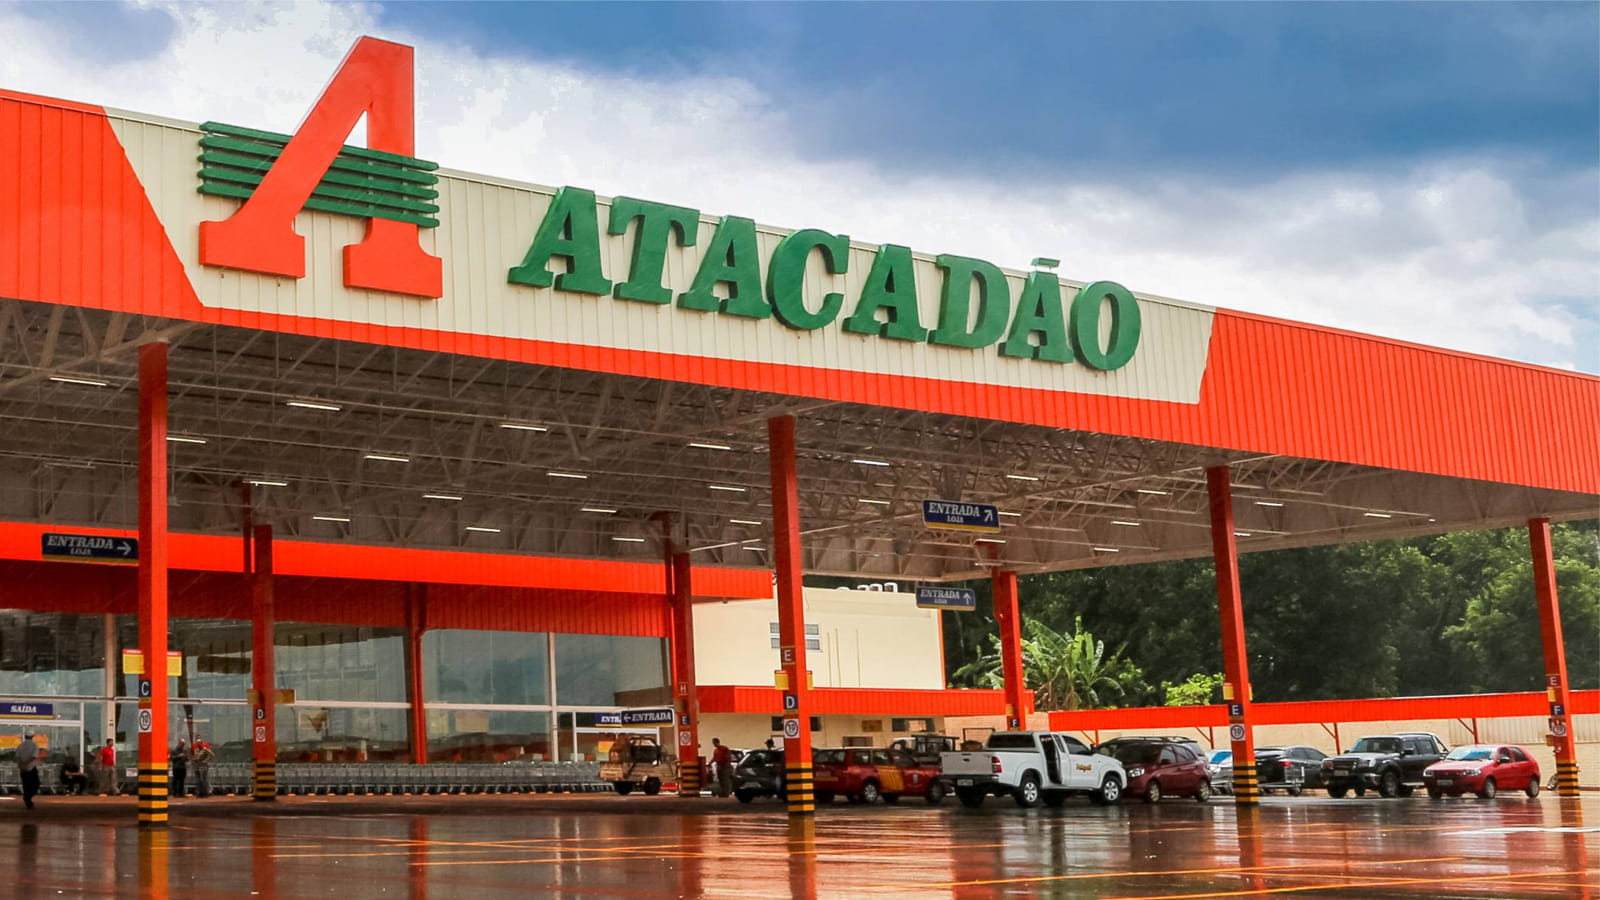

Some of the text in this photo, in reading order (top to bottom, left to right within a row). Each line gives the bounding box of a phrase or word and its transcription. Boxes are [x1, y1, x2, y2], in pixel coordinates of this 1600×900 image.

[199, 36, 442, 299] A
[508, 186, 1141, 371] ATACADÃO
[928, 503, 980, 517] ENTRADA
[47, 535, 114, 550] ENTRADA
[919, 589, 960, 600] ENTRADA
[784, 650, 792, 661] E
[141, 681, 149, 696] C
[786, 696, 795, 708] D
[10, 704, 37, 713] SAÍDA
[257, 708, 264, 719] D
[1231, 704, 1240, 715] E
[1553, 705, 1561, 715] F
[631, 712, 672, 722] ENTRADA
